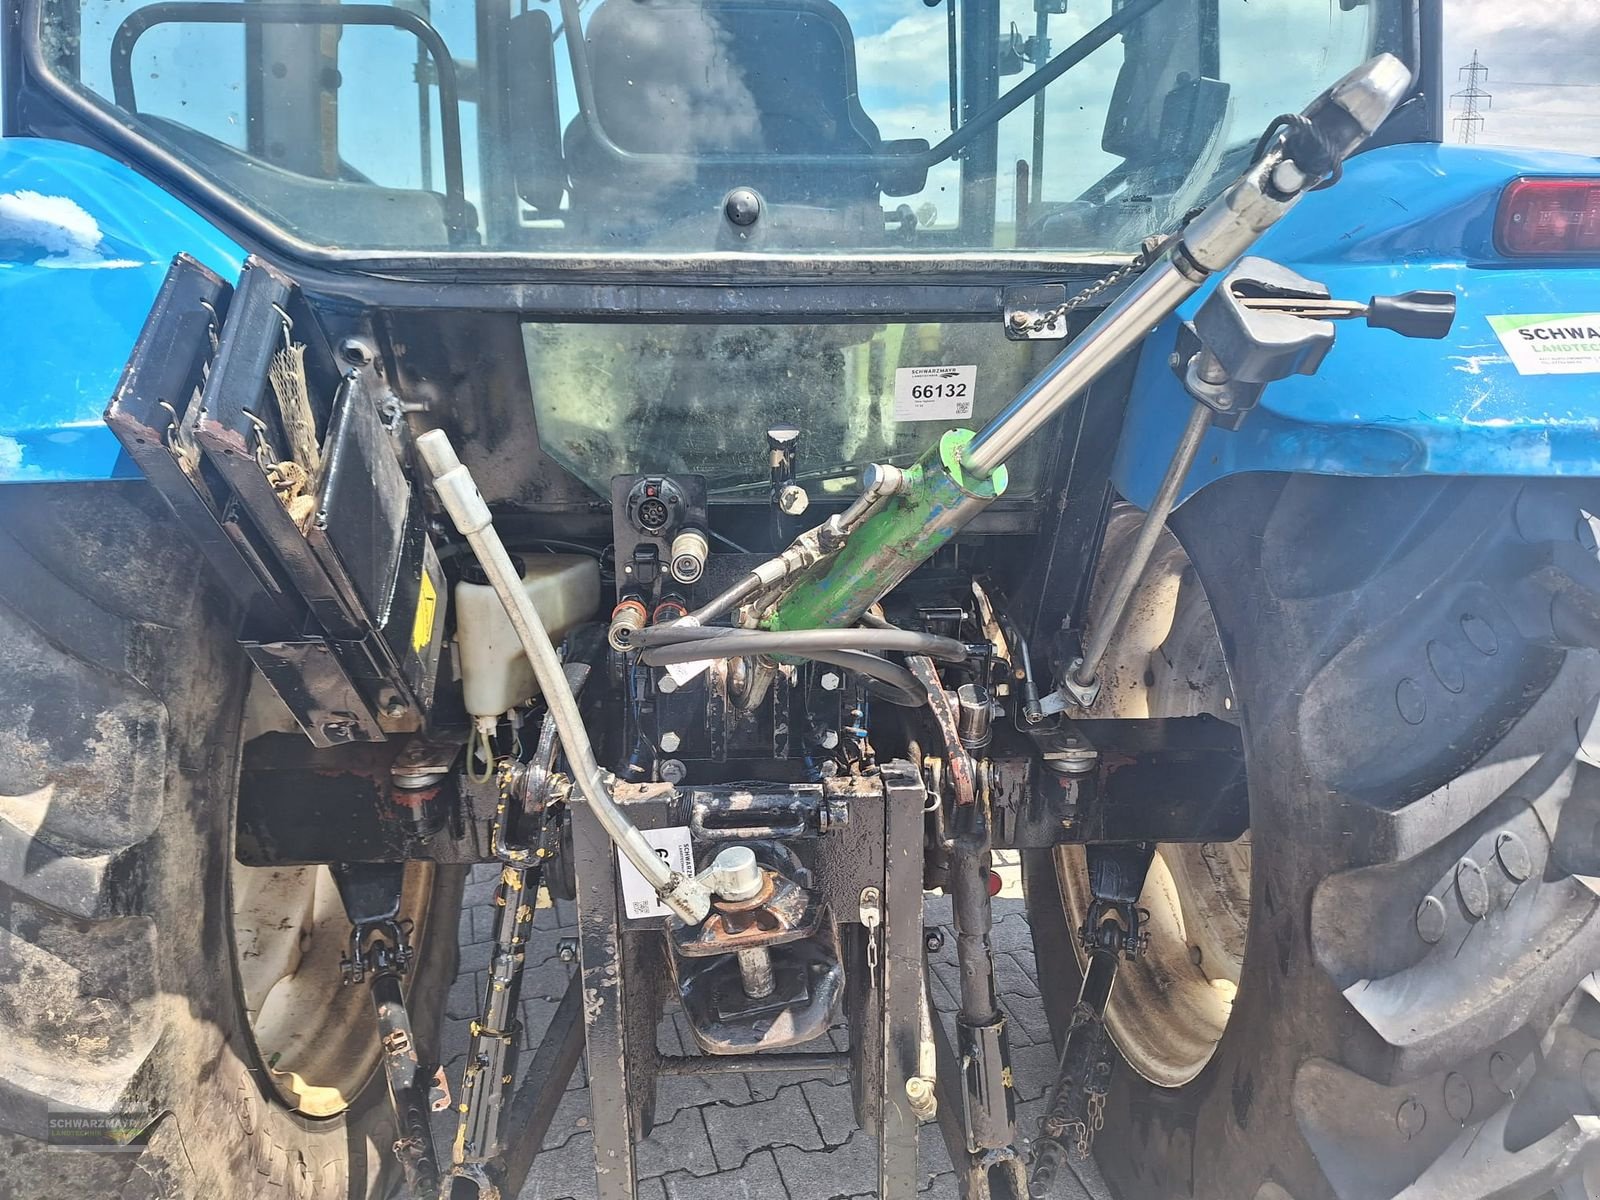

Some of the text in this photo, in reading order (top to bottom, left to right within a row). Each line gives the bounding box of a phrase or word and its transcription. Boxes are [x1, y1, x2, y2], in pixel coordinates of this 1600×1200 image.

[1518, 327, 1600, 340] SCHWA
[1531, 343, 1600, 353] LANDTEC
[912, 383, 967, 399] 66132
